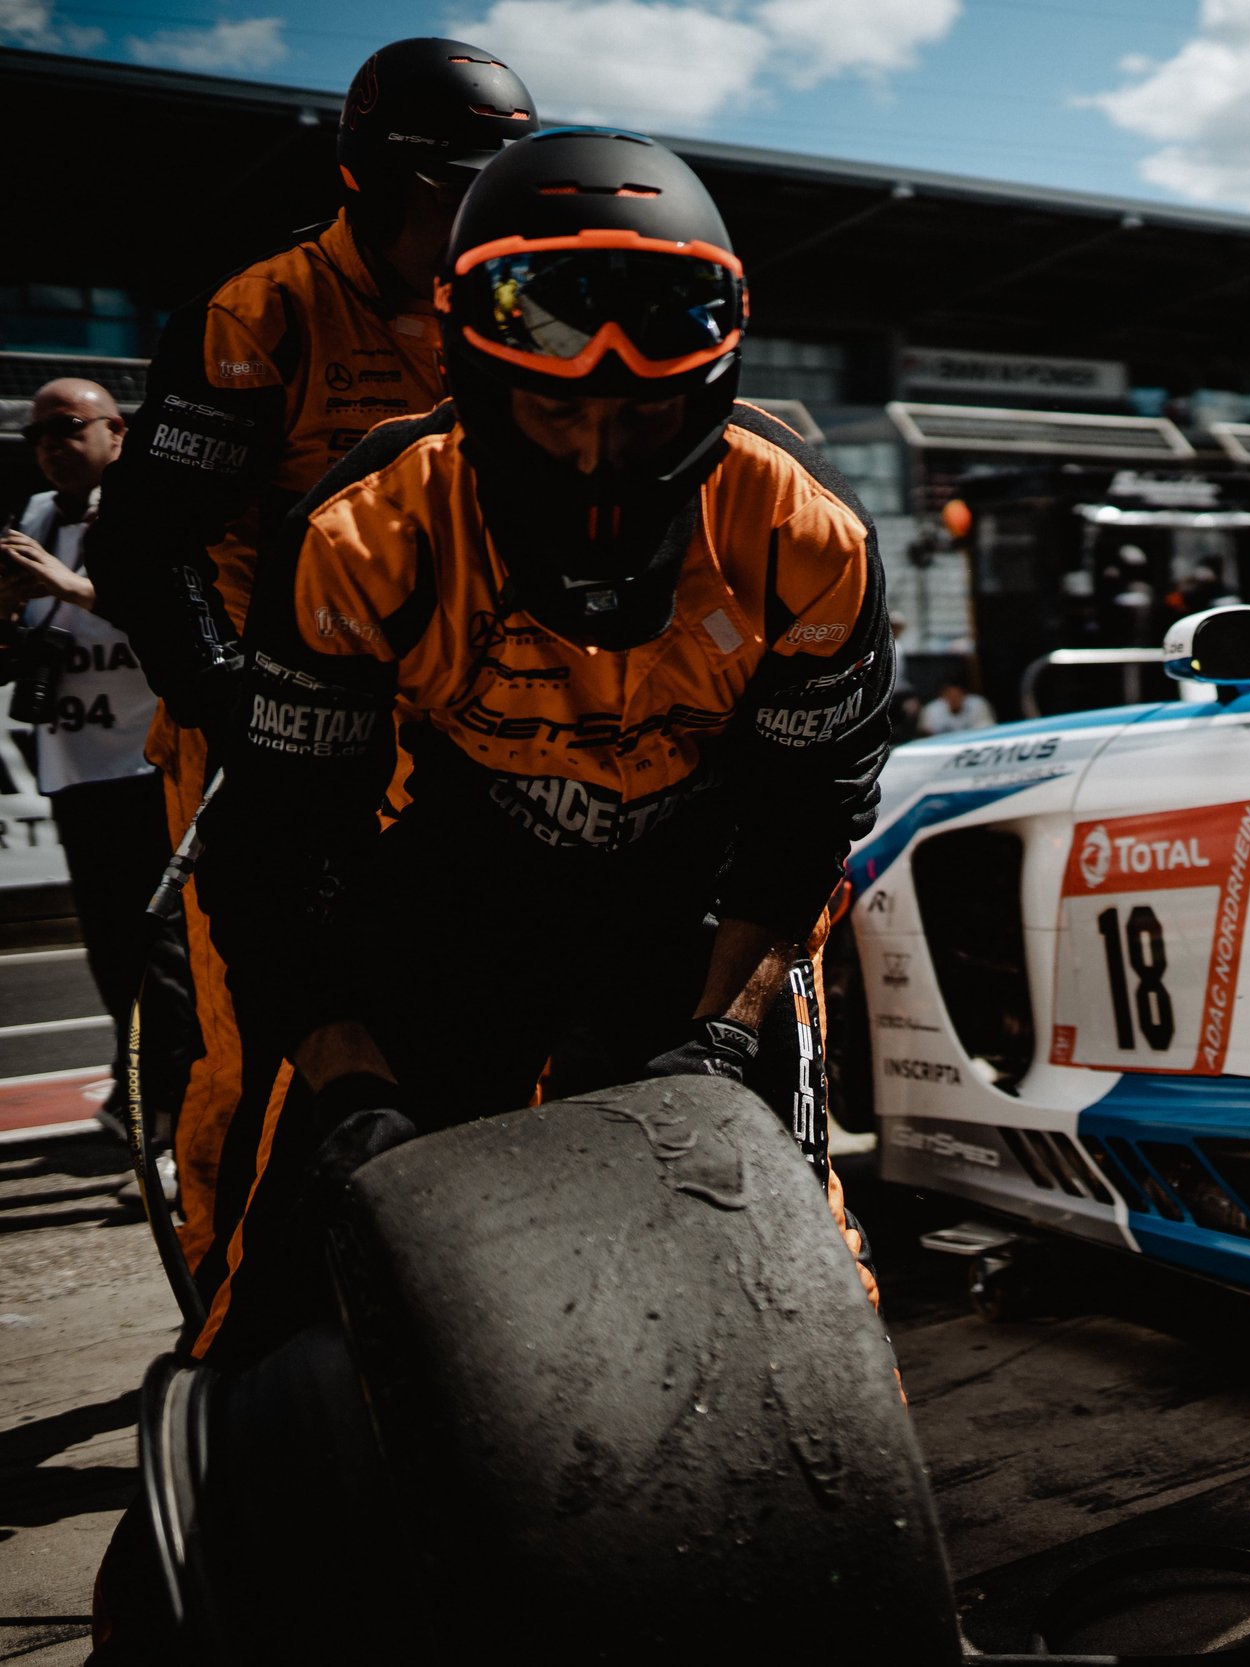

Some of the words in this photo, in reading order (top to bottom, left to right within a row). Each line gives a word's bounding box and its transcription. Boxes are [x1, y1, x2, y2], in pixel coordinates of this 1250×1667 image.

[784, 619, 849, 646] freem
[62, 642, 139, 673] DIA
[1114, 835, 1211, 876] TOTAL
[1097, 906, 1176, 1052] 18
[1201, 984, 1229, 1071] ADAC
[883, 1056, 962, 1085] INSCRIPTA
